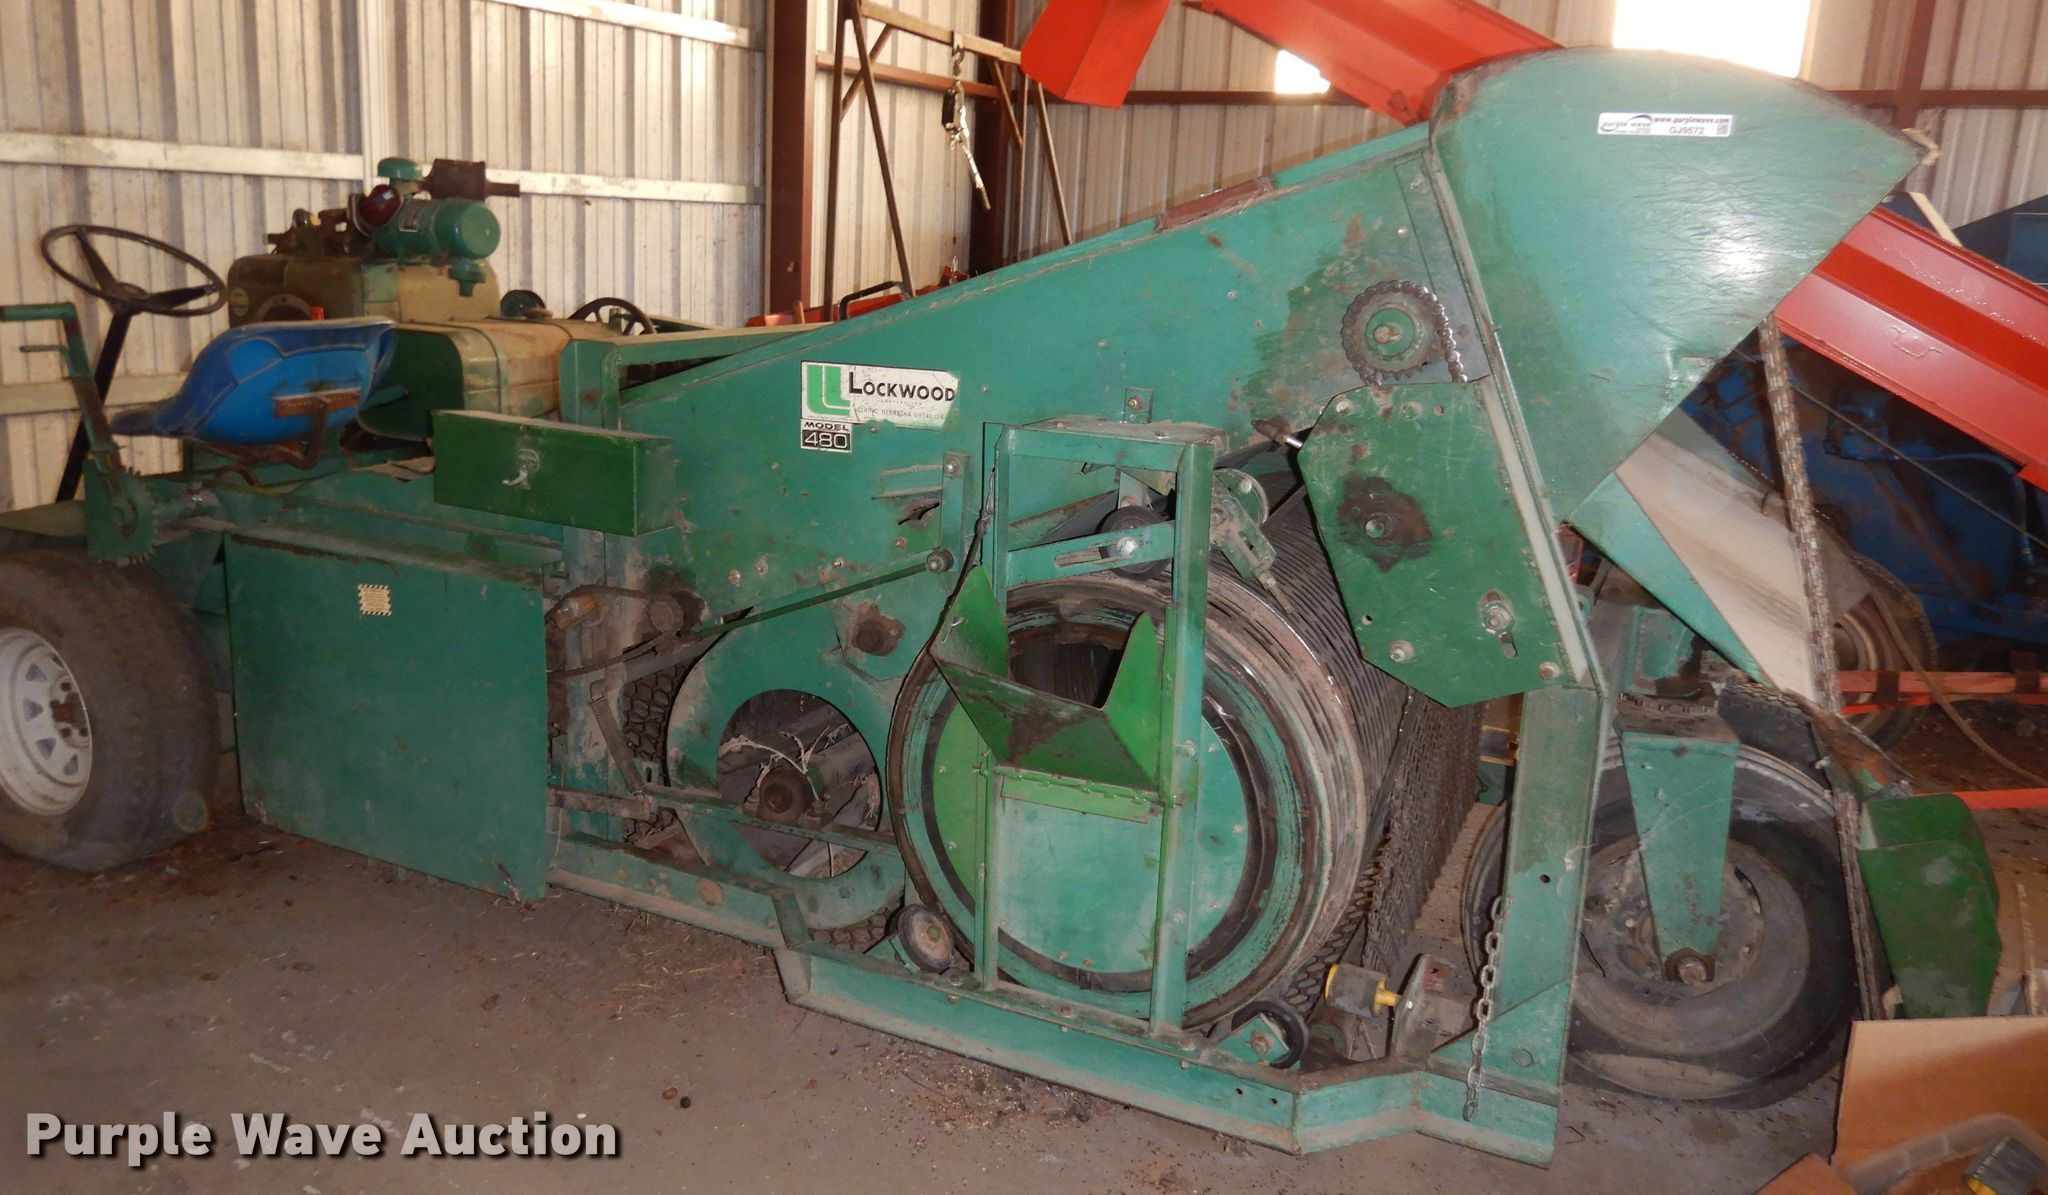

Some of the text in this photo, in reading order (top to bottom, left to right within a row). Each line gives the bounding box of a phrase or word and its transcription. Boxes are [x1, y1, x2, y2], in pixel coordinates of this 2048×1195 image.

[1654, 116, 1730, 124] www.purplewave.com
[1669, 126, 1704, 134] GJ9572
[848, 371, 956, 402] LOCKWOOD
[803, 421, 849, 431] MODEL
[804, 432, 848, 449] 480
